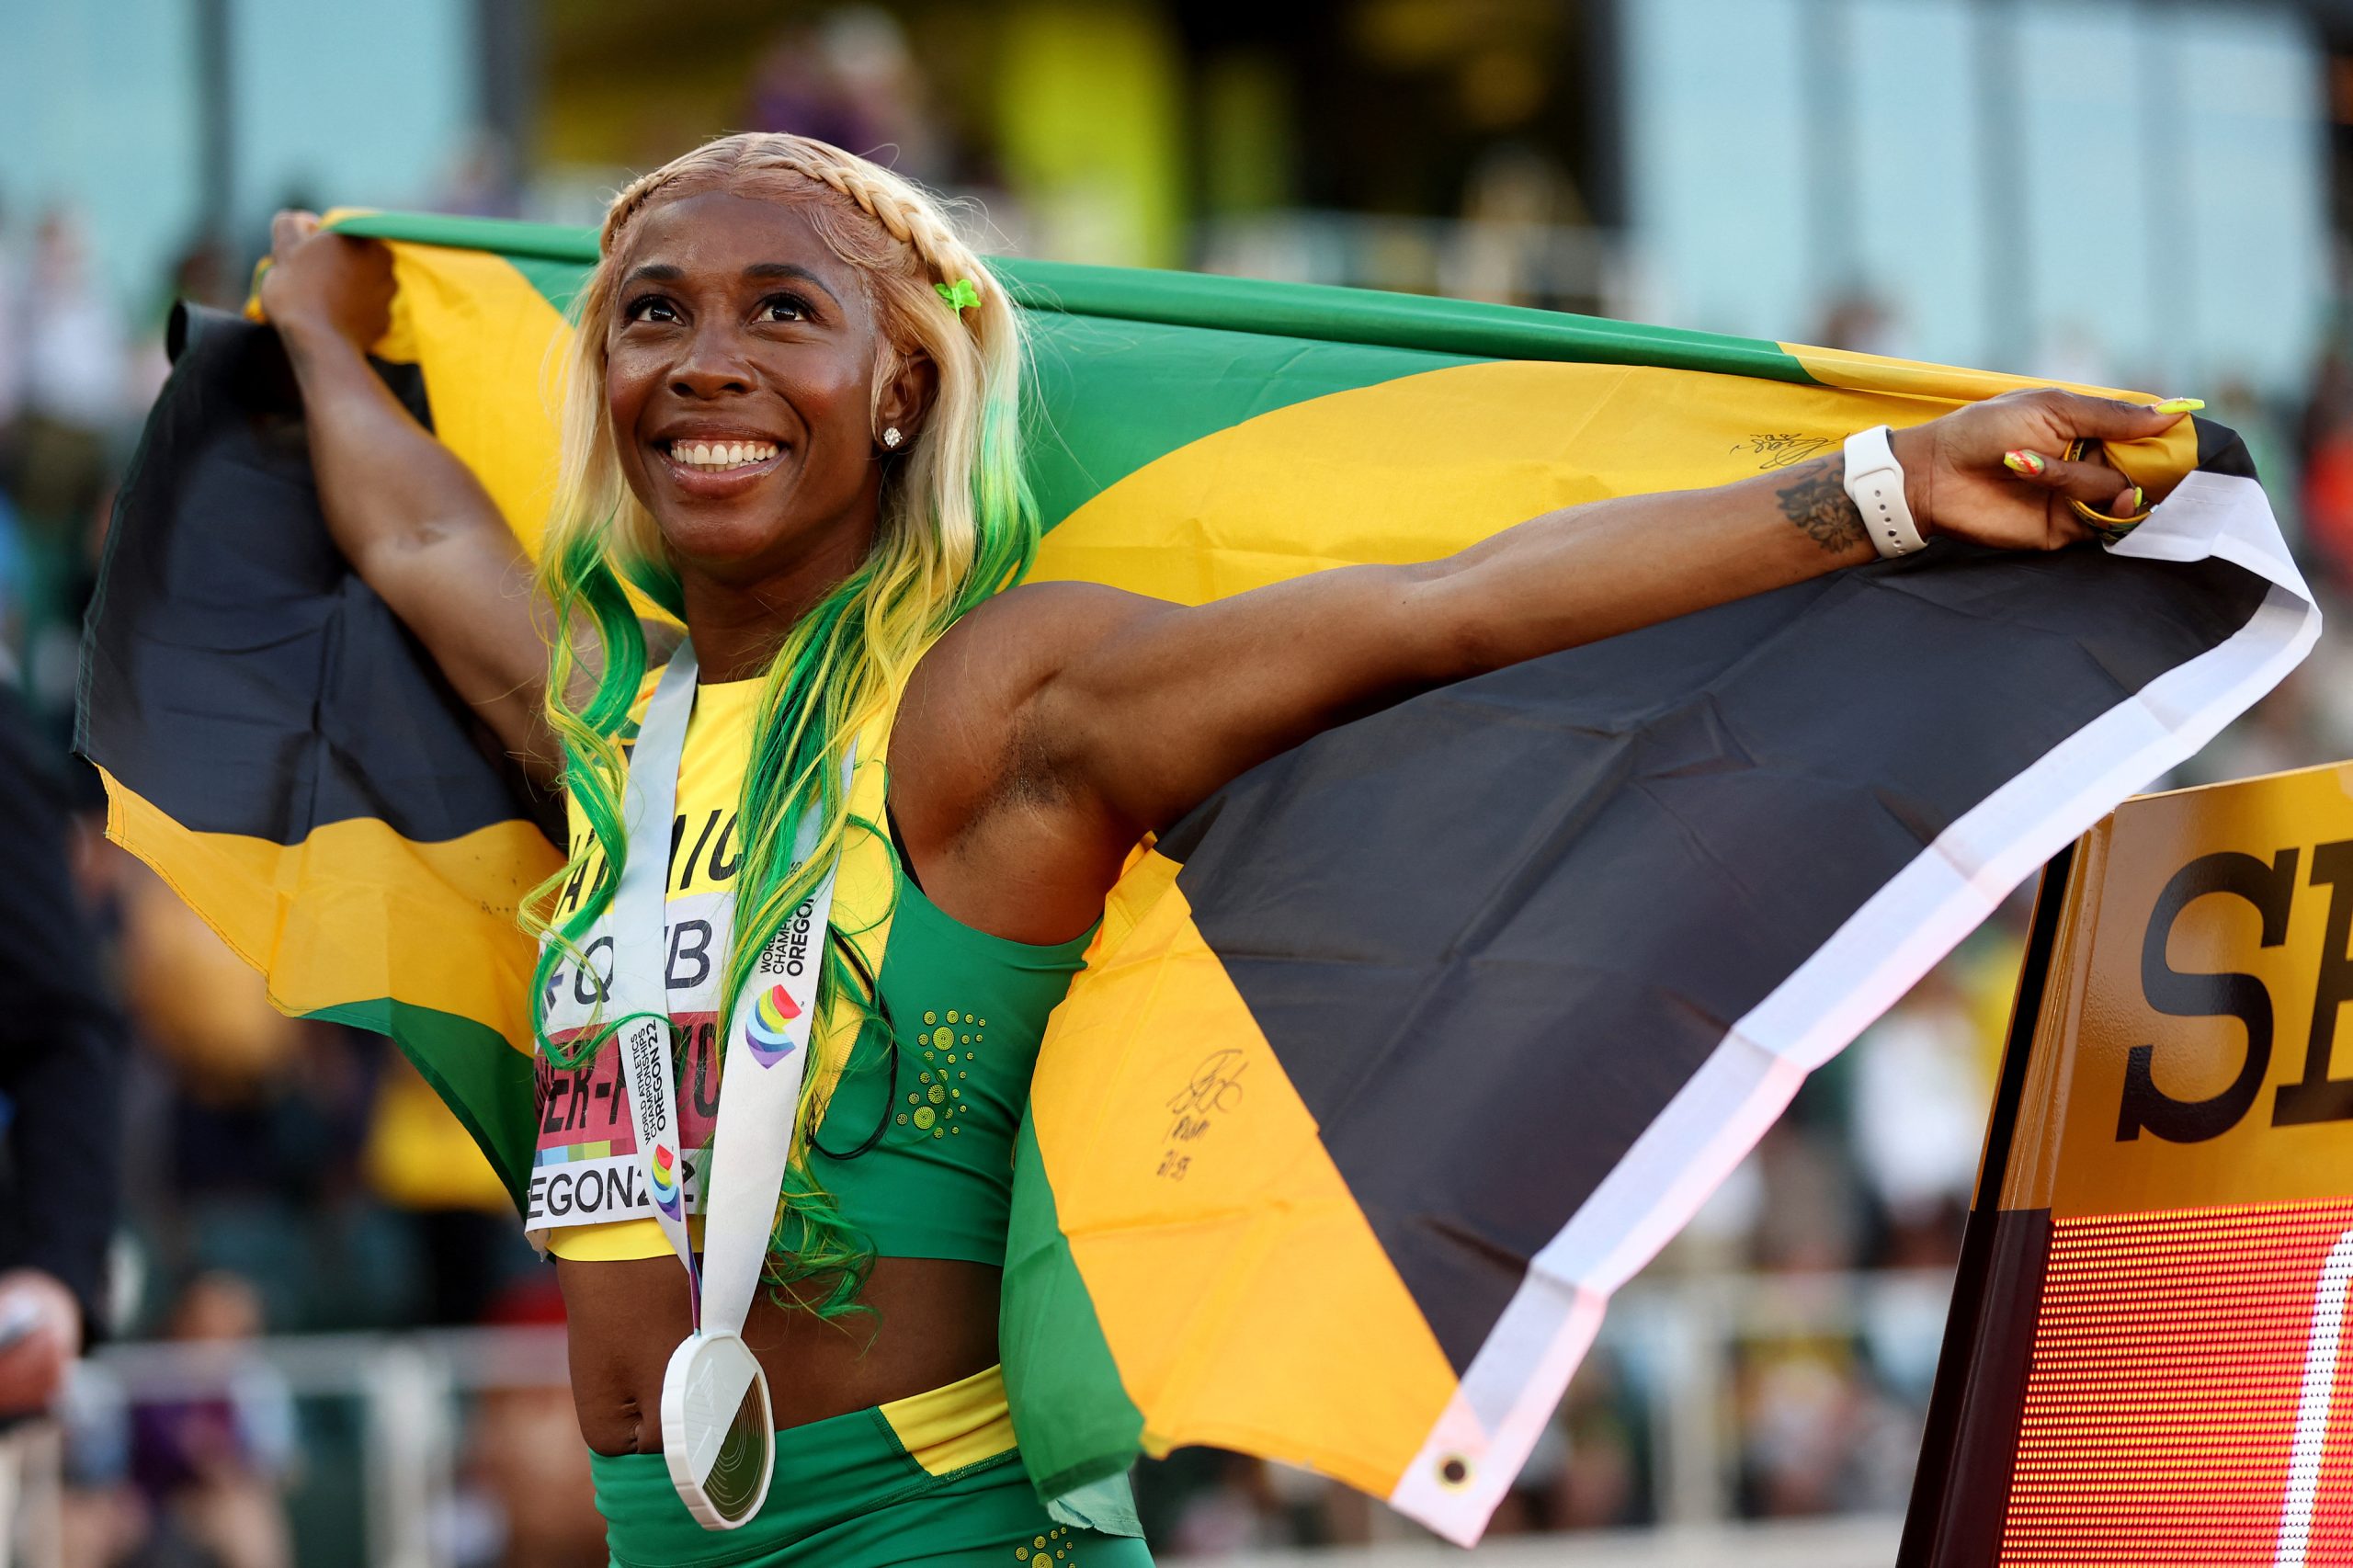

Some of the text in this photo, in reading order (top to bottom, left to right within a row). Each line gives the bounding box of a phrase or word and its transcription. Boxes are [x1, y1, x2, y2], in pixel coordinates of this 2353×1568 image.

[760, 932, 777, 974] WORL
[787, 898, 814, 976] OREGO
[631, 1033, 652, 1145] WORLD ATHLETICS
[638, 1028, 657, 1138] CHAMPIONSHIPS
[646, 1018, 666, 1132] OREGON22
